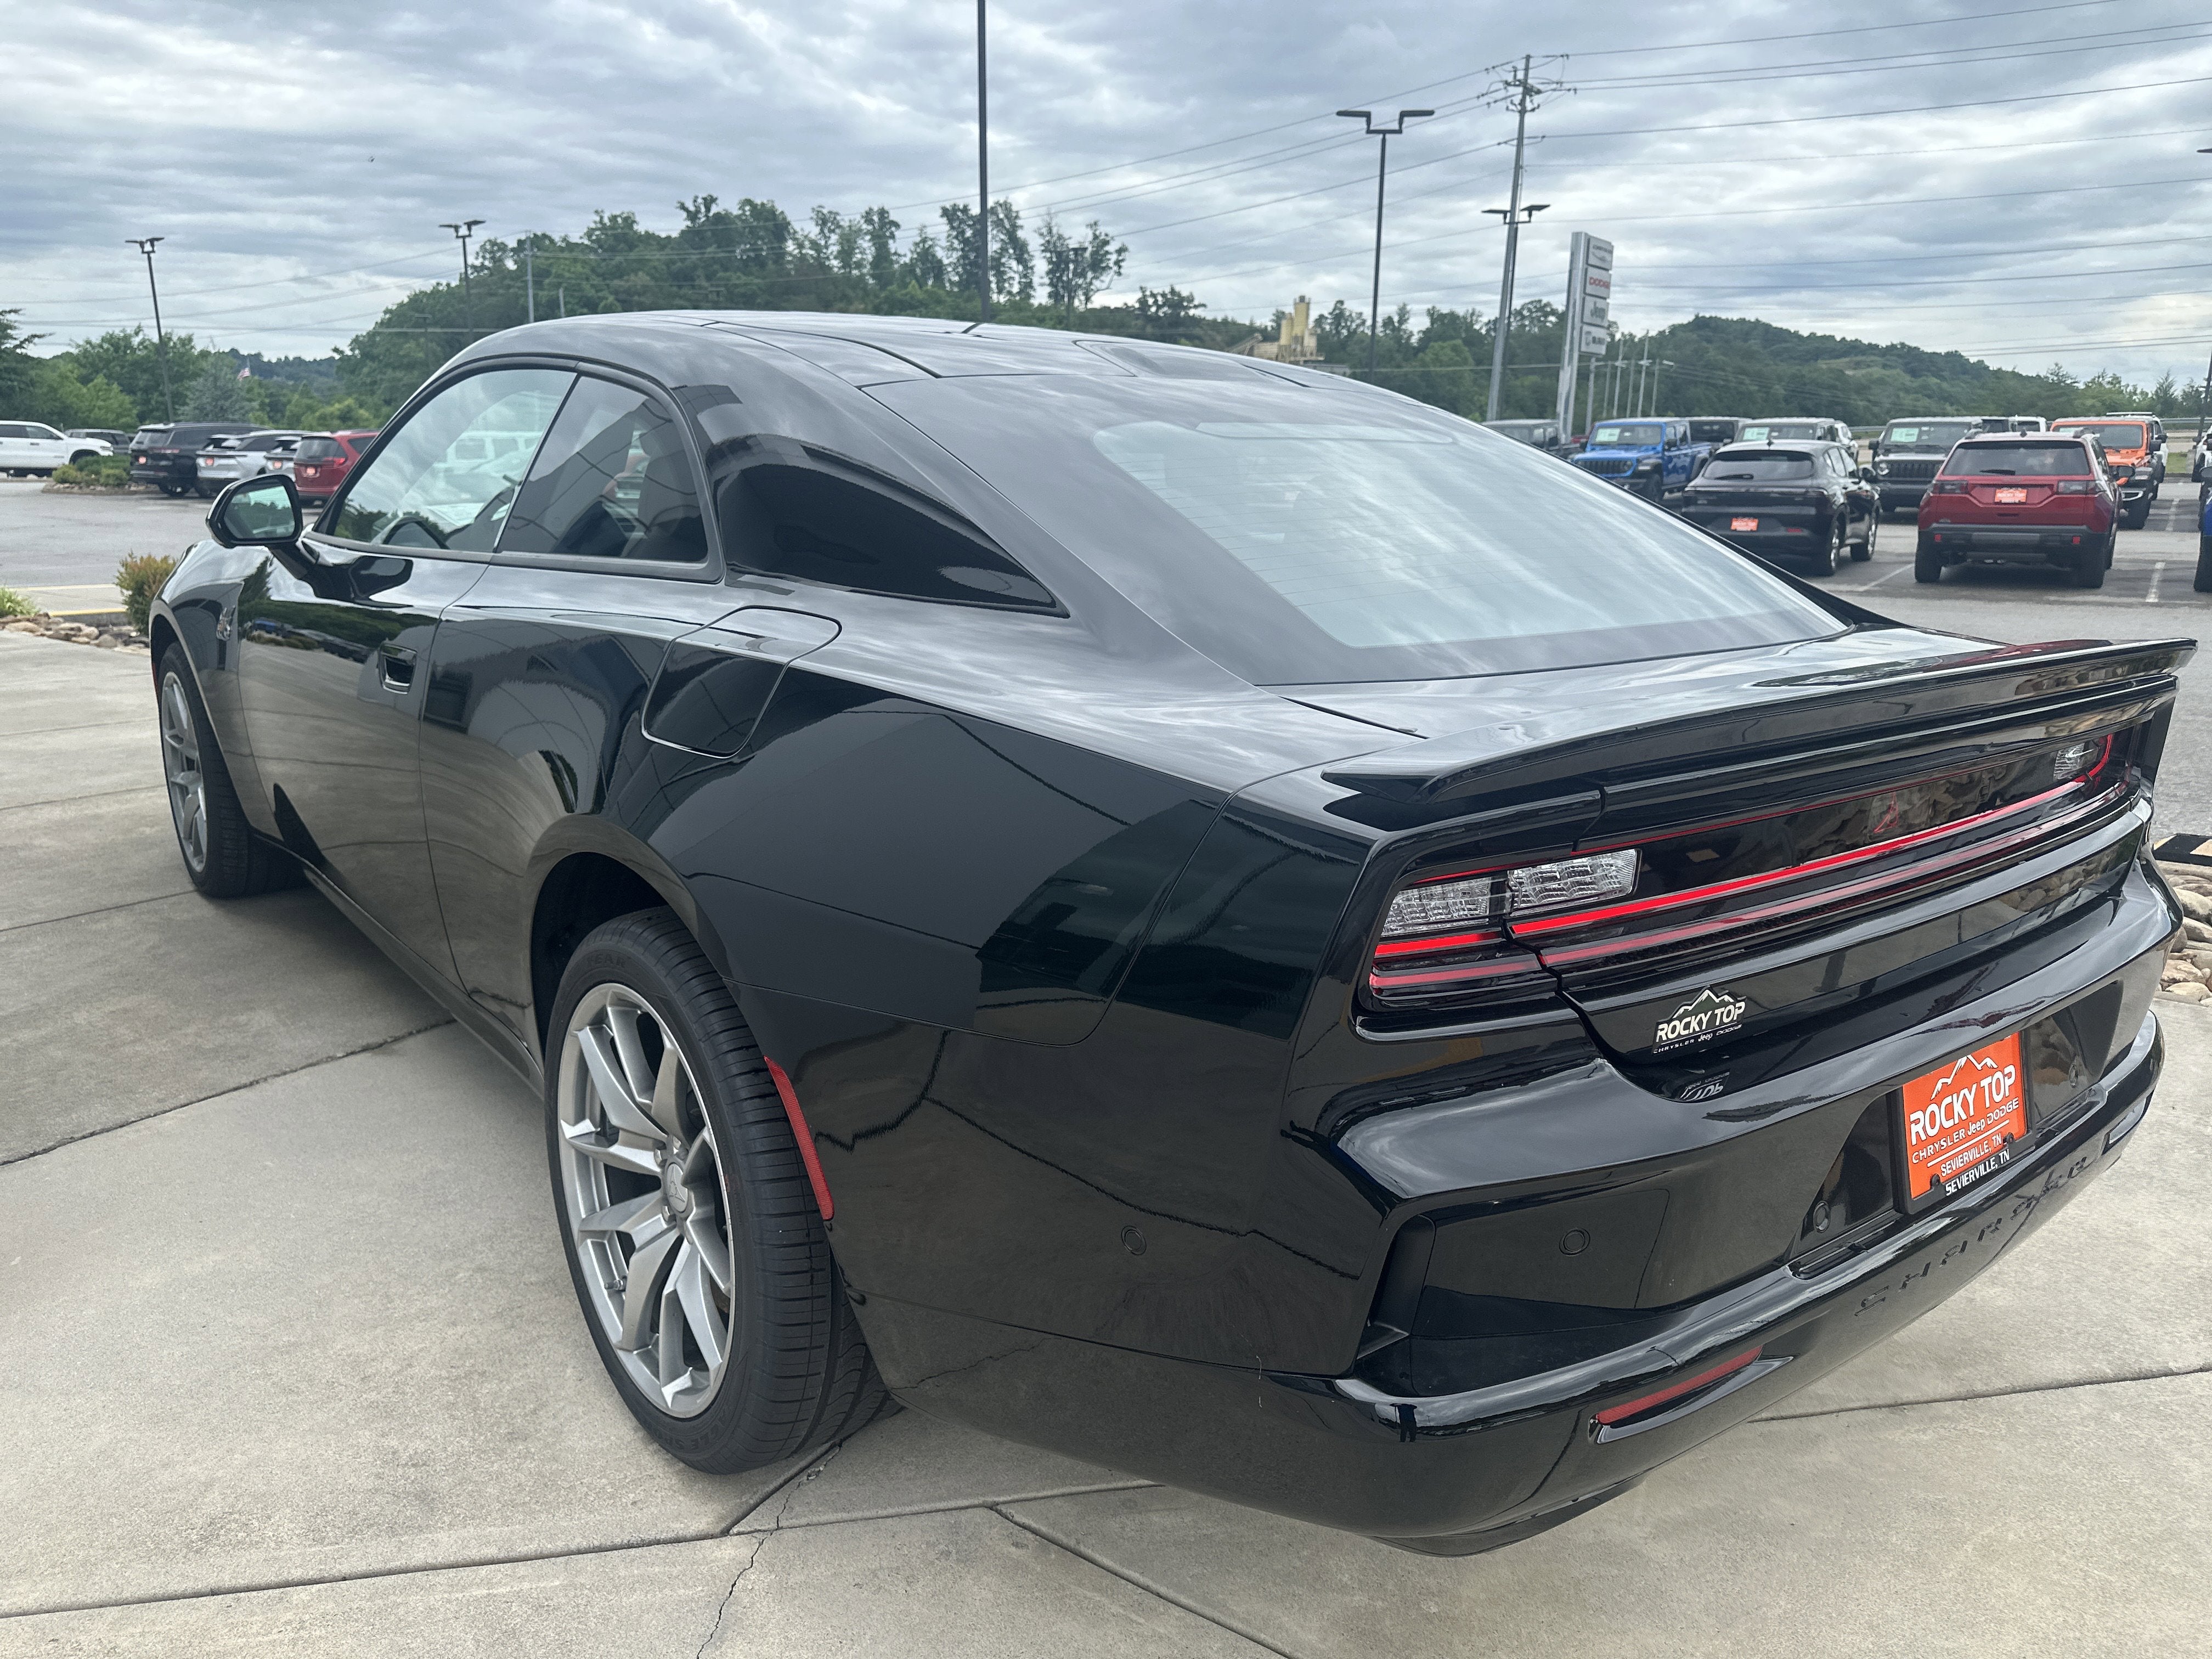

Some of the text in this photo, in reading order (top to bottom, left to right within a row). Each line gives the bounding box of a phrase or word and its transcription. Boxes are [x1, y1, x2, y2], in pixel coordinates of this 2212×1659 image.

[1653, 1039, 1695, 1053] CHRYSLER
[1698, 1032, 1713, 1041] Jeep
[1656, 1001, 1746, 1042] ROCKY TOP
[1910, 1064, 2016, 1146] ROCKY TOP
[1911, 1097, 2019, 1164] CHRYSLER Jeep DODGE
[1940, 1132, 2002, 1177] SEVIERVILLE, TN
[1945, 1148, 2010, 1197] SEVIERVILLE, TN
